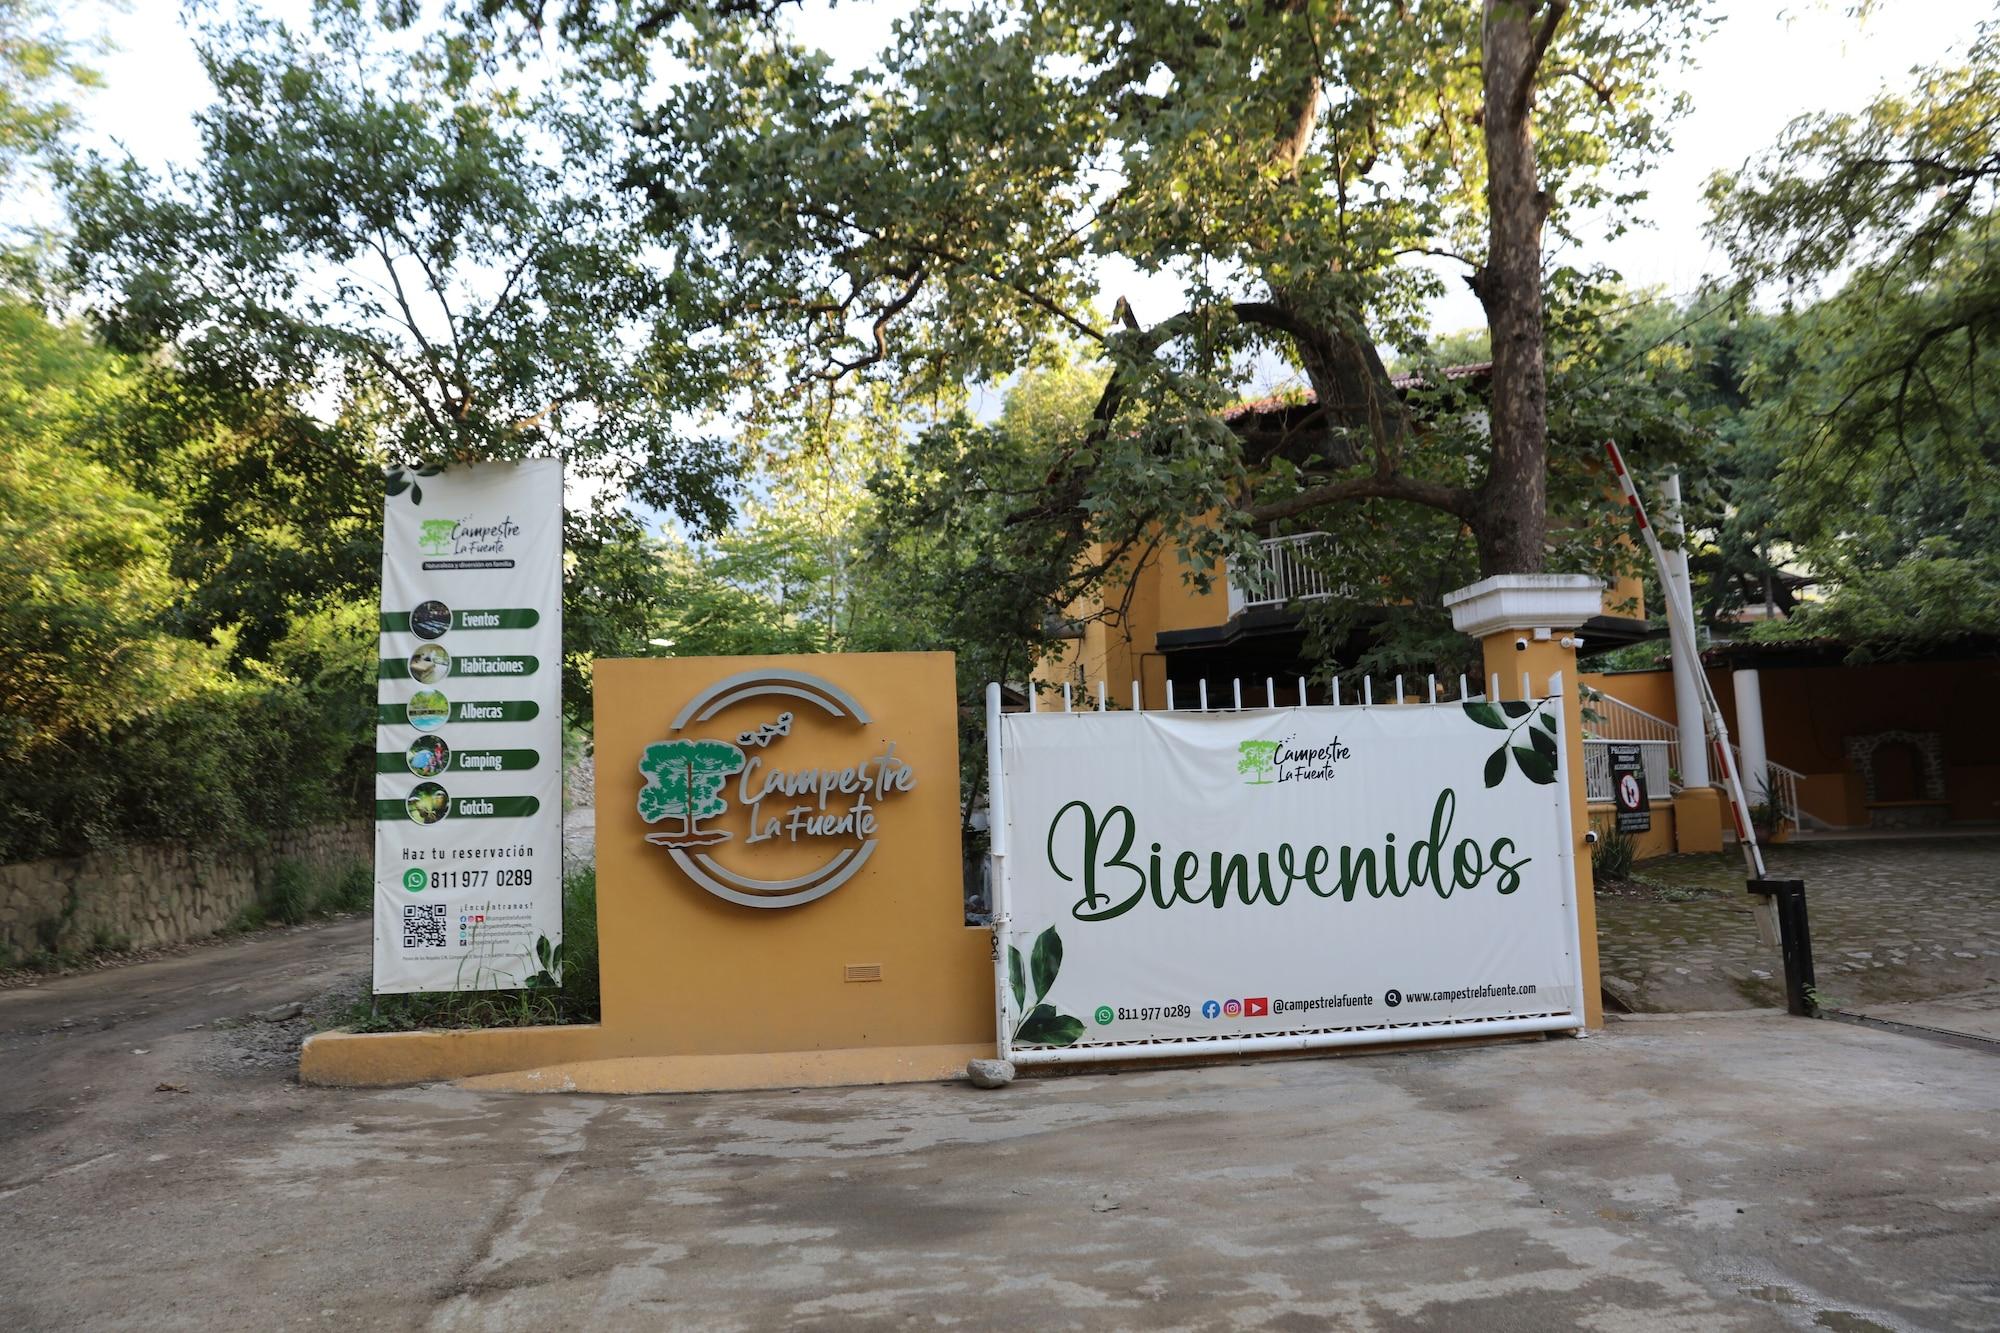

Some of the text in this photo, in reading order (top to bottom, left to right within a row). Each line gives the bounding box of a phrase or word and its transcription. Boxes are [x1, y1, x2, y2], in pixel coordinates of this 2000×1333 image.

[451, 515, 521, 542] Campestre
[453, 537, 505, 555] La Fuente
[462, 612, 500, 627] Eventos
[460, 657, 525, 674] Habitaciones
[459, 703, 503, 719] Albercas
[1273, 735, 1351, 767] Campestre
[459, 752, 503, 771] Camping
[1278, 760, 1335, 783] La Fuente
[739, 741, 917, 811] Campestre
[459, 799, 494, 816] Gotcha
[745, 793, 880, 844] La Fuente
[402, 844, 534, 860] Haz tu reservación
[1047, 787, 1532, 922] Bienvenidos
[431, 869, 533, 889] 811 977 0289
[1273, 992, 1373, 1014] @campestrelafuente
[1406, 983, 1537, 1004] www.campestrelafuente.com
[1118, 1004, 1191, 1021] 811 977 0289
